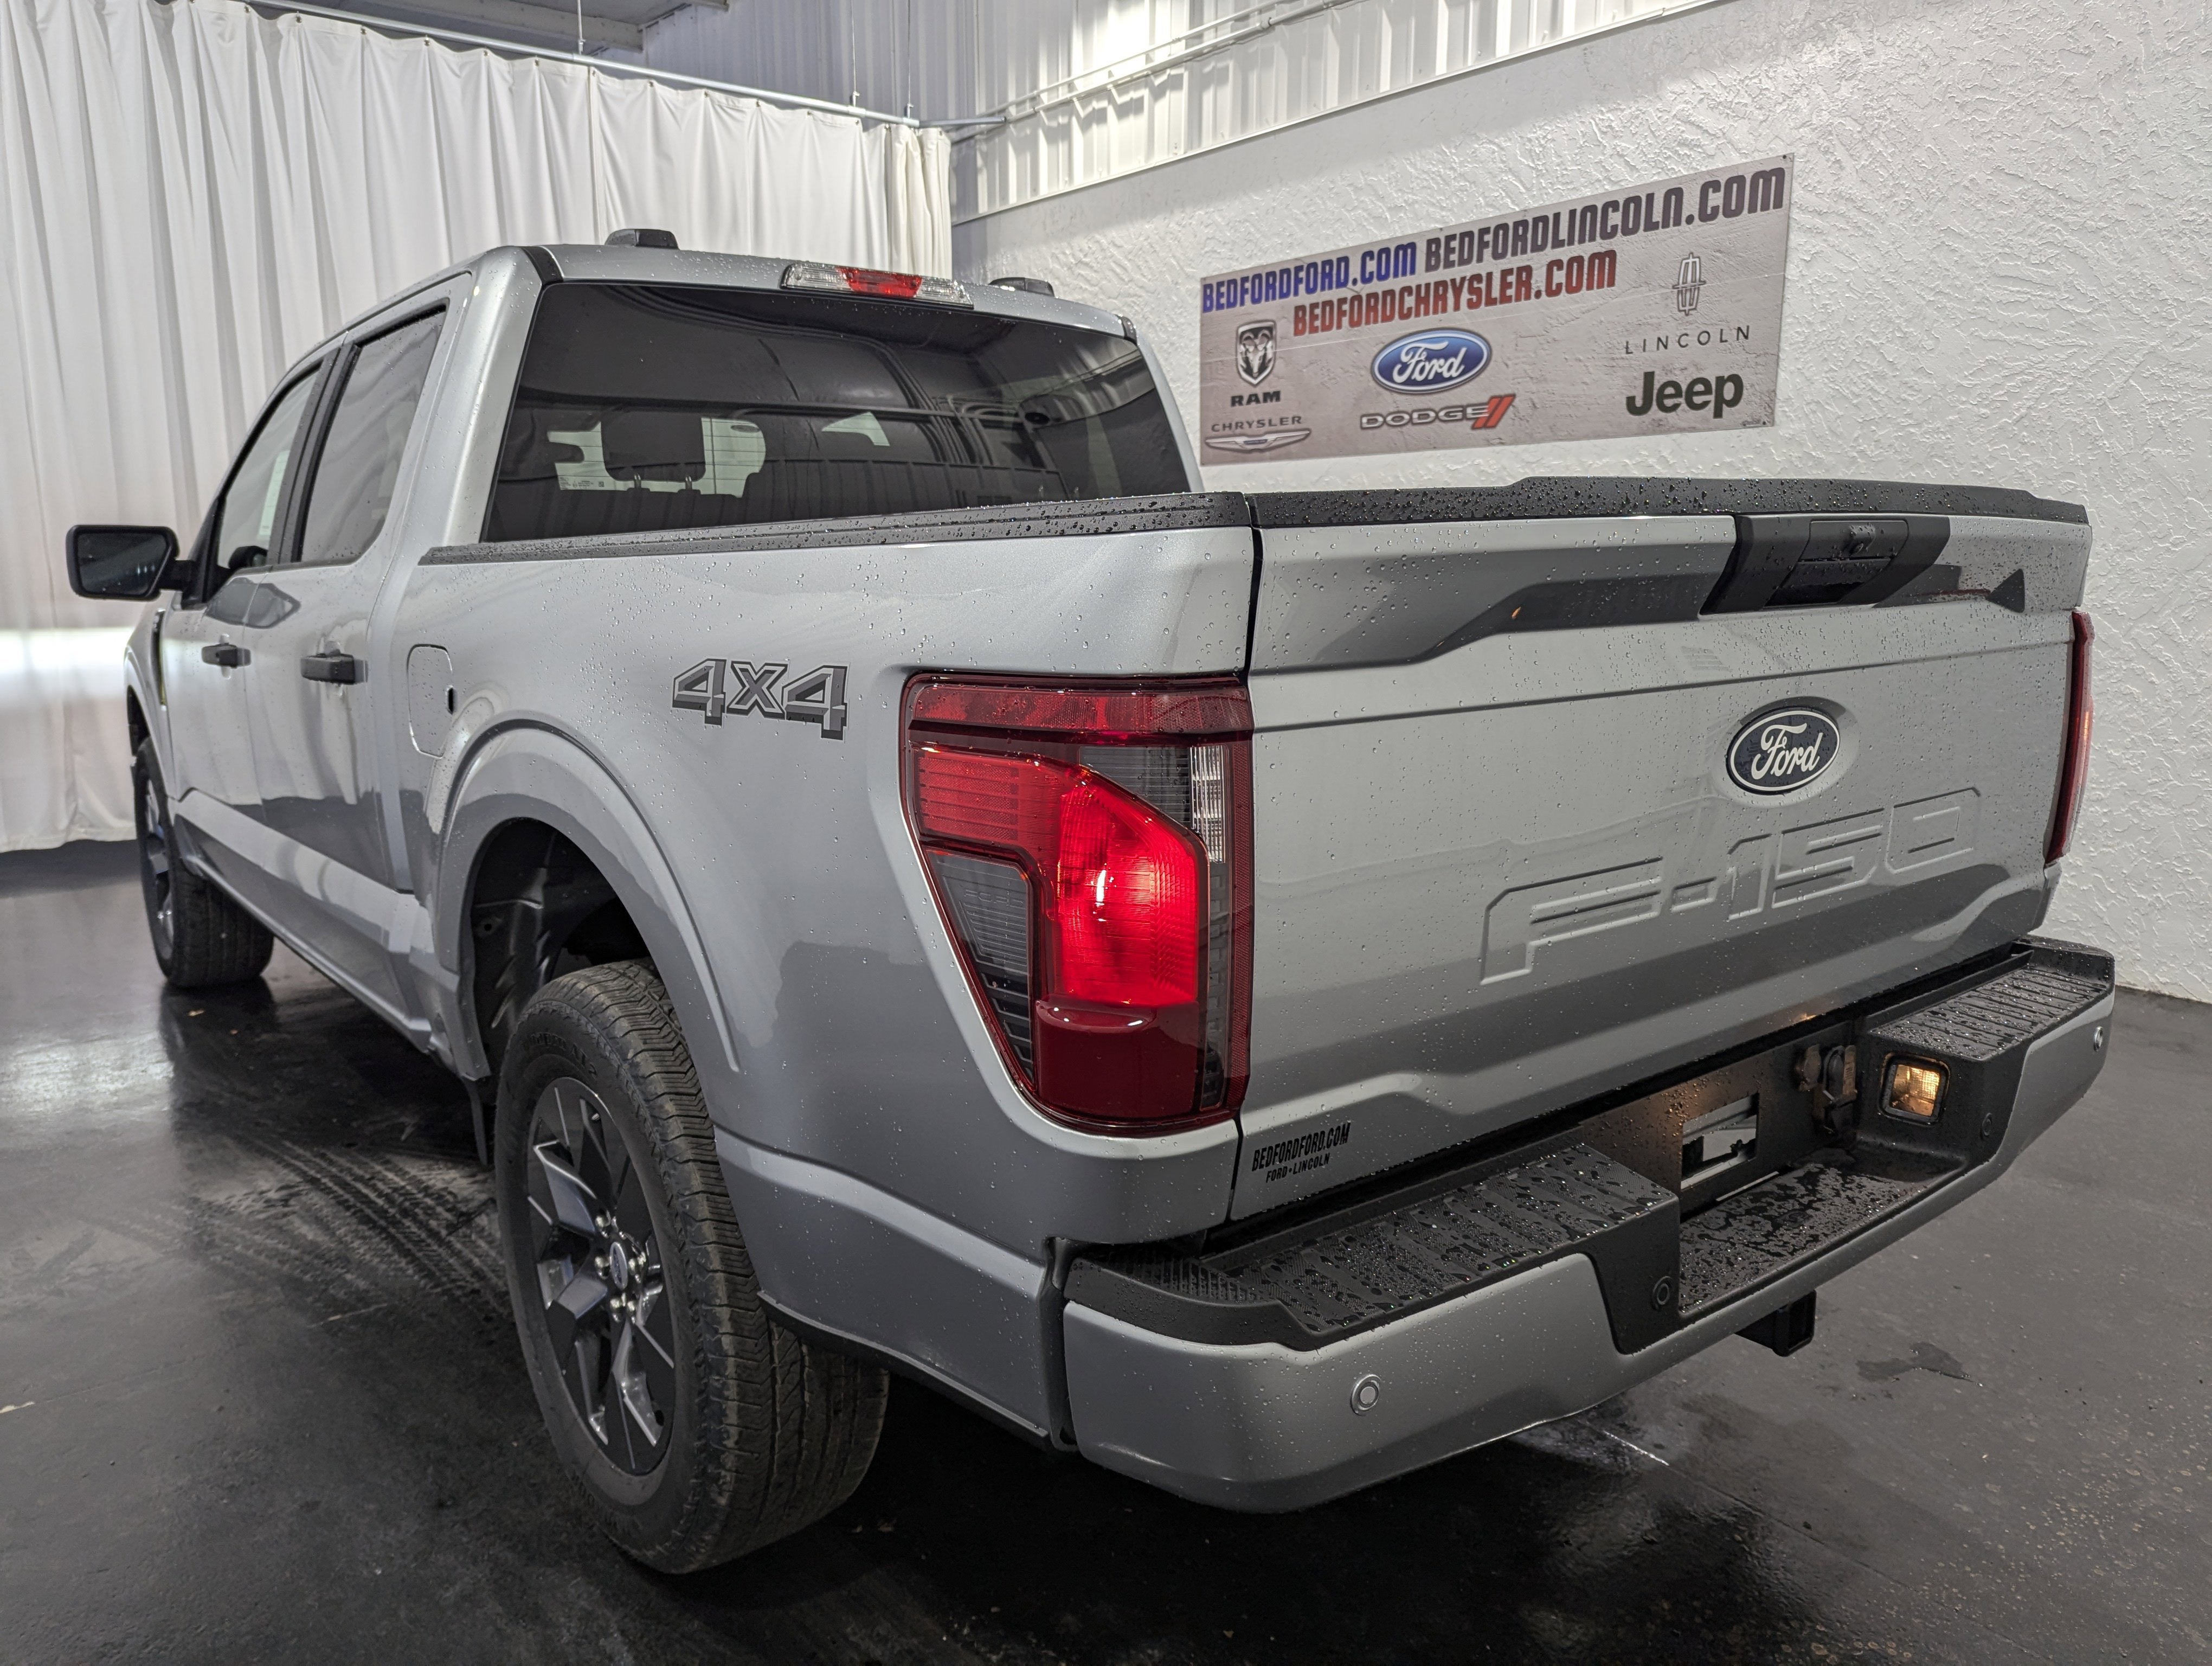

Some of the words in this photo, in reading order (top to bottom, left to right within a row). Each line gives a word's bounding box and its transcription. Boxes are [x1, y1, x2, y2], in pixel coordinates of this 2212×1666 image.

[1202, 242, 1417, 313] BEDFORDFORD.COM
[1424, 166, 1786, 272] BEDFORDLINCOLN.COM
[1293, 249, 1617, 337] BEDFORDCHRYSLER.COM
[1392, 341, 1468, 384] Ford
[1625, 325, 1751, 355] LINCOLN
[1230, 390, 1281, 407] RAM
[1360, 401, 1490, 430] DODGE
[1625, 370, 1745, 420] Jeep
[1210, 415, 1303, 433] CHRYSLER
[672, 657, 849, 741] 4X4
[1750, 721, 1825, 780] Ford
[1480, 786, 1982, 986] F-150
[1251, 1122, 1352, 1172] BEDFORDFORD.COM
